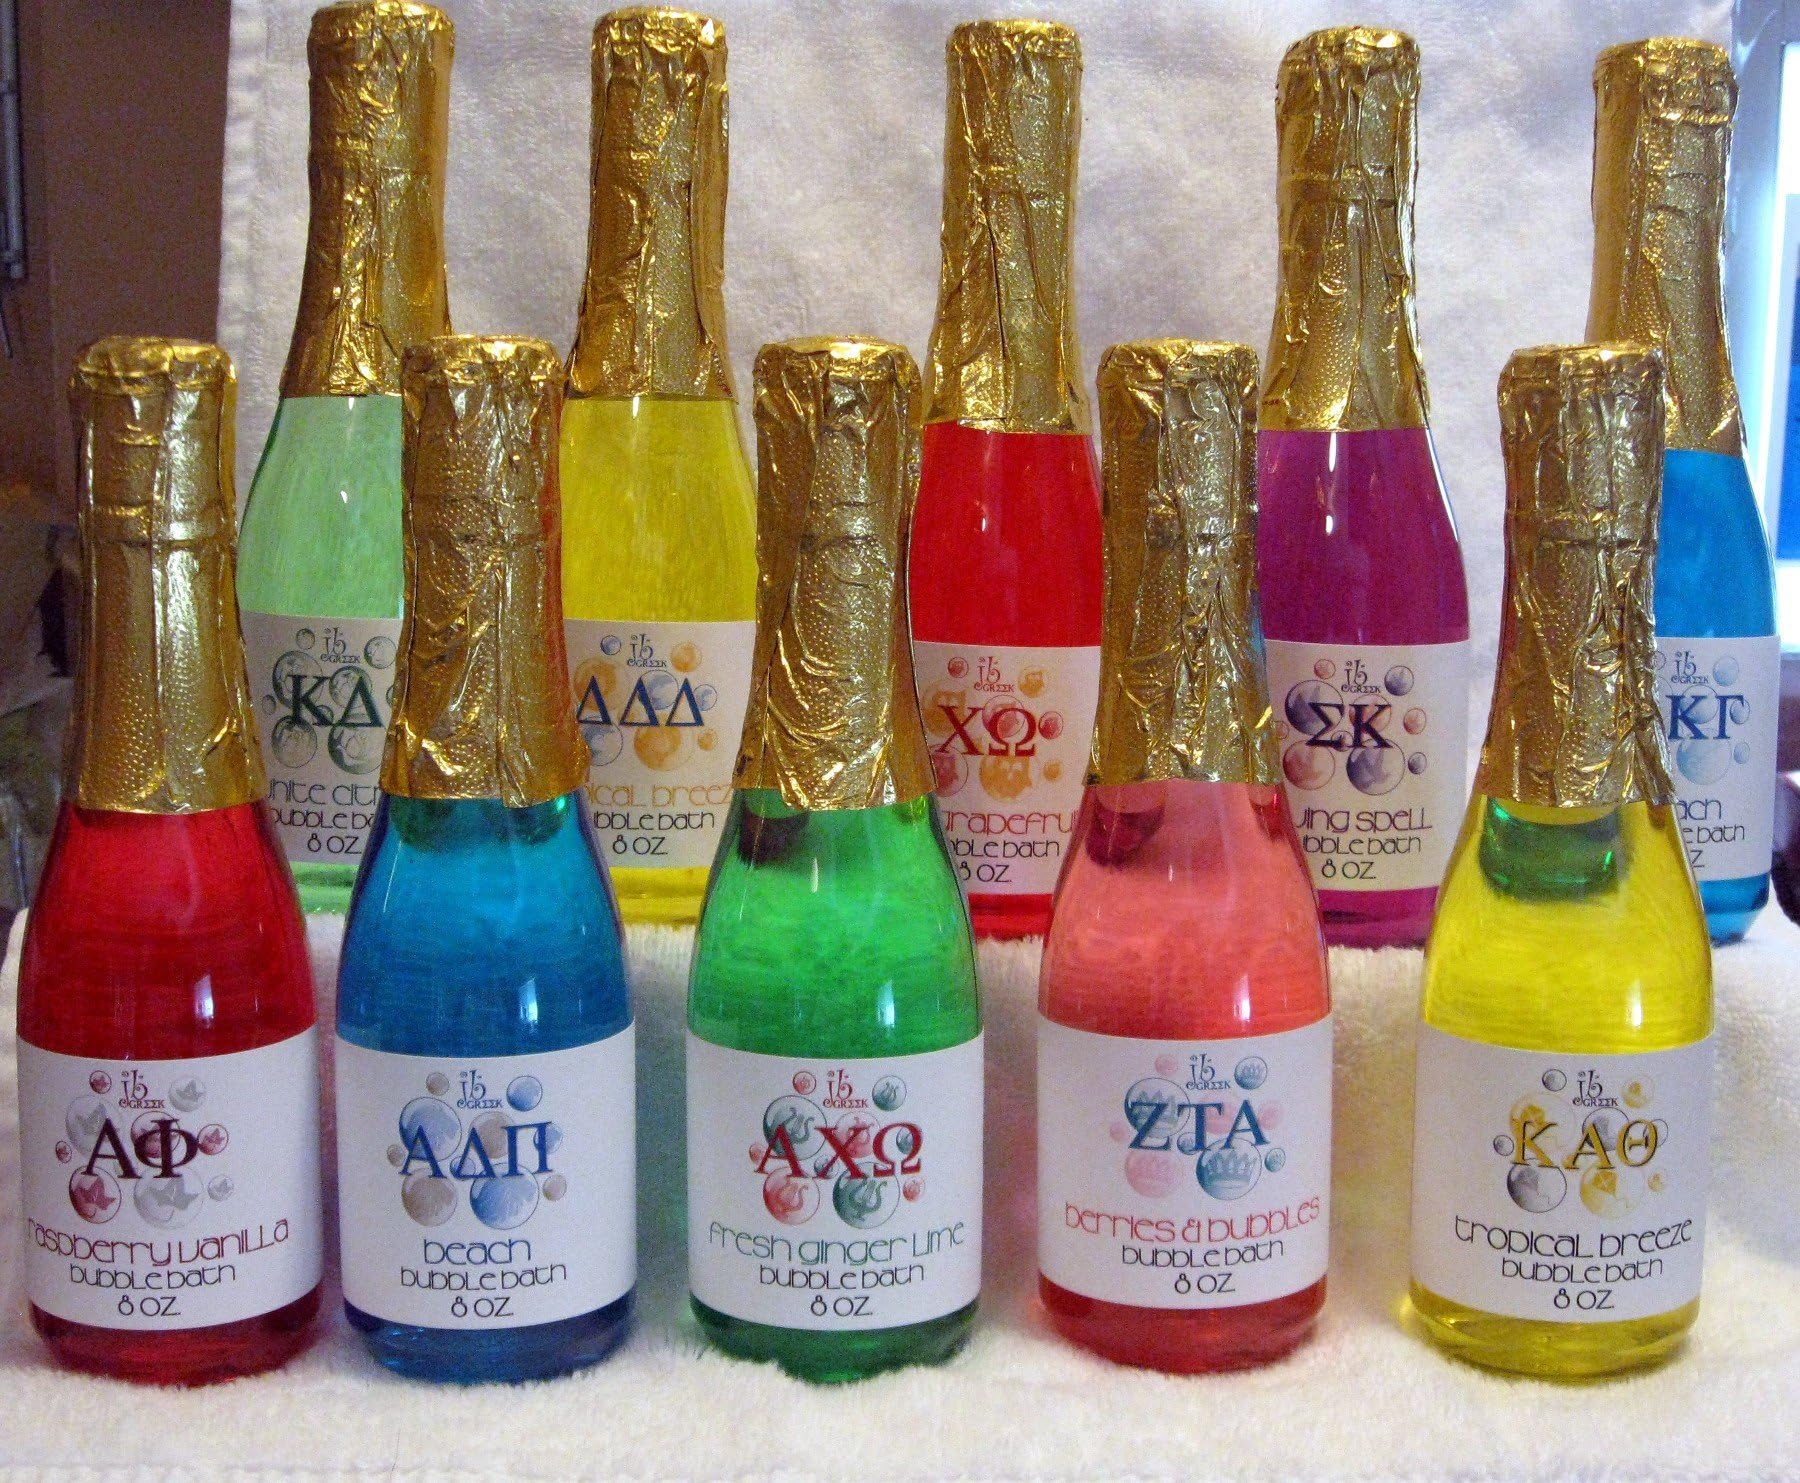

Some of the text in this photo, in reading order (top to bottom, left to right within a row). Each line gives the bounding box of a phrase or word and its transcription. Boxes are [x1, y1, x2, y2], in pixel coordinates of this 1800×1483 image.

[576, 675, 705, 727] ΔΔΔ
[332, 784, 381, 806] citr
[594, 810, 715, 831] bble bath
[1356, 807, 1433, 833] spell
[1677, 799, 1722, 820] ach
[307, 832, 321, 852] 8
[612, 834, 627, 854] 8
[1697, 824, 1745, 843] bath
[1003, 839, 1060, 858] bath
[1303, 835, 1421, 855] bble bath
[1322, 858, 1336, 878] 8
[1065, 1196, 1321, 1243] berries & bubbles
[28, 1217, 289, 1267] raspberry vanilla
[709, 1221, 964, 1266] fresh ginger lime
[1455, 1214, 1692, 1258] tropical breeze
[423, 1238, 532, 1265] beach
[1122, 1239, 1284, 1268] bubble bath
[70, 1263, 236, 1290] bubble bath
[400, 1263, 567, 1291] bubble bath
[759, 1263, 924, 1290] bubble bath
[1502, 1257, 1663, 1283] bubble bath
[1174, 1273, 1191, 1295] 8
[118, 1294, 134, 1316] 8
[451, 1296, 467, 1317] 8
[810, 1295, 827, 1316] 8
[1553, 1288, 1570, 1309] 8
